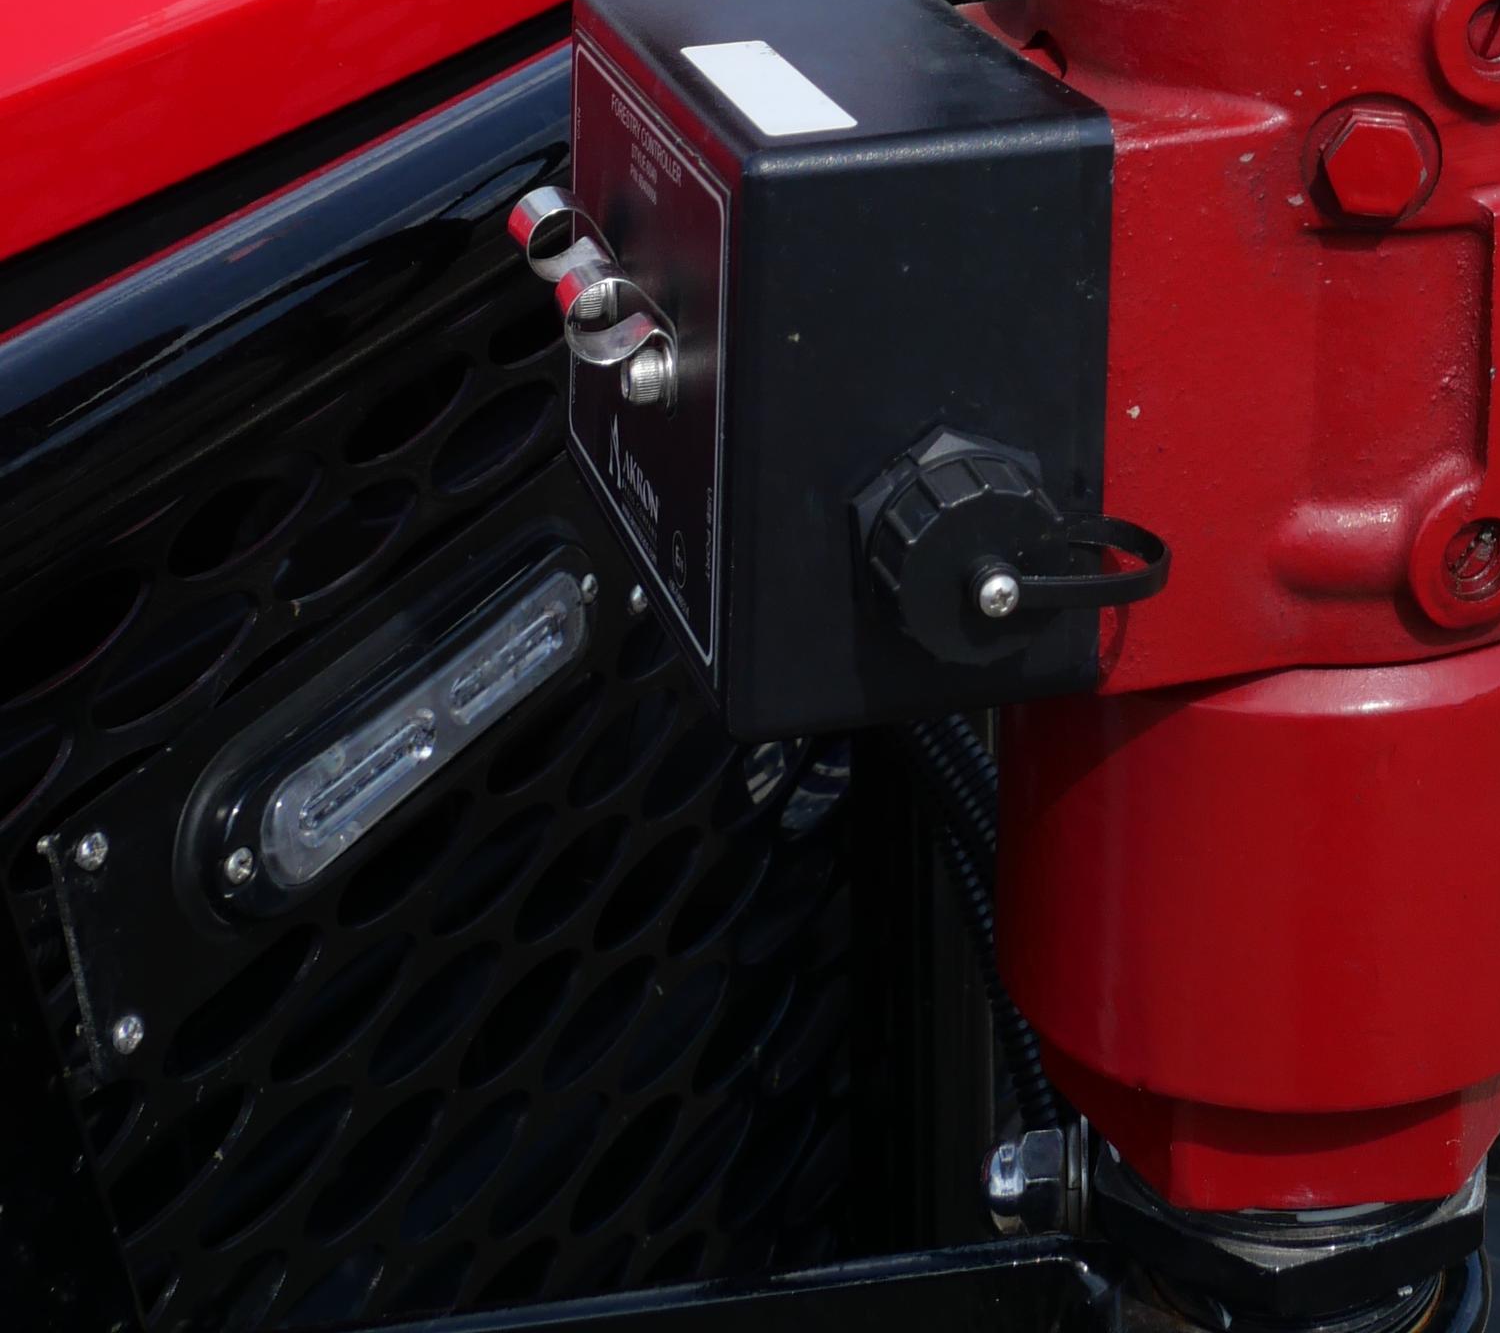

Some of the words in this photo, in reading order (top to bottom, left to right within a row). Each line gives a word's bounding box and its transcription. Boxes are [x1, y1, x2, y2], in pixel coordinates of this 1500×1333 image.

[611, 93, 641, 140] FORESTRY
[640, 127, 682, 187] CONTROLLER
[622, 449, 660, 523] AKRON
